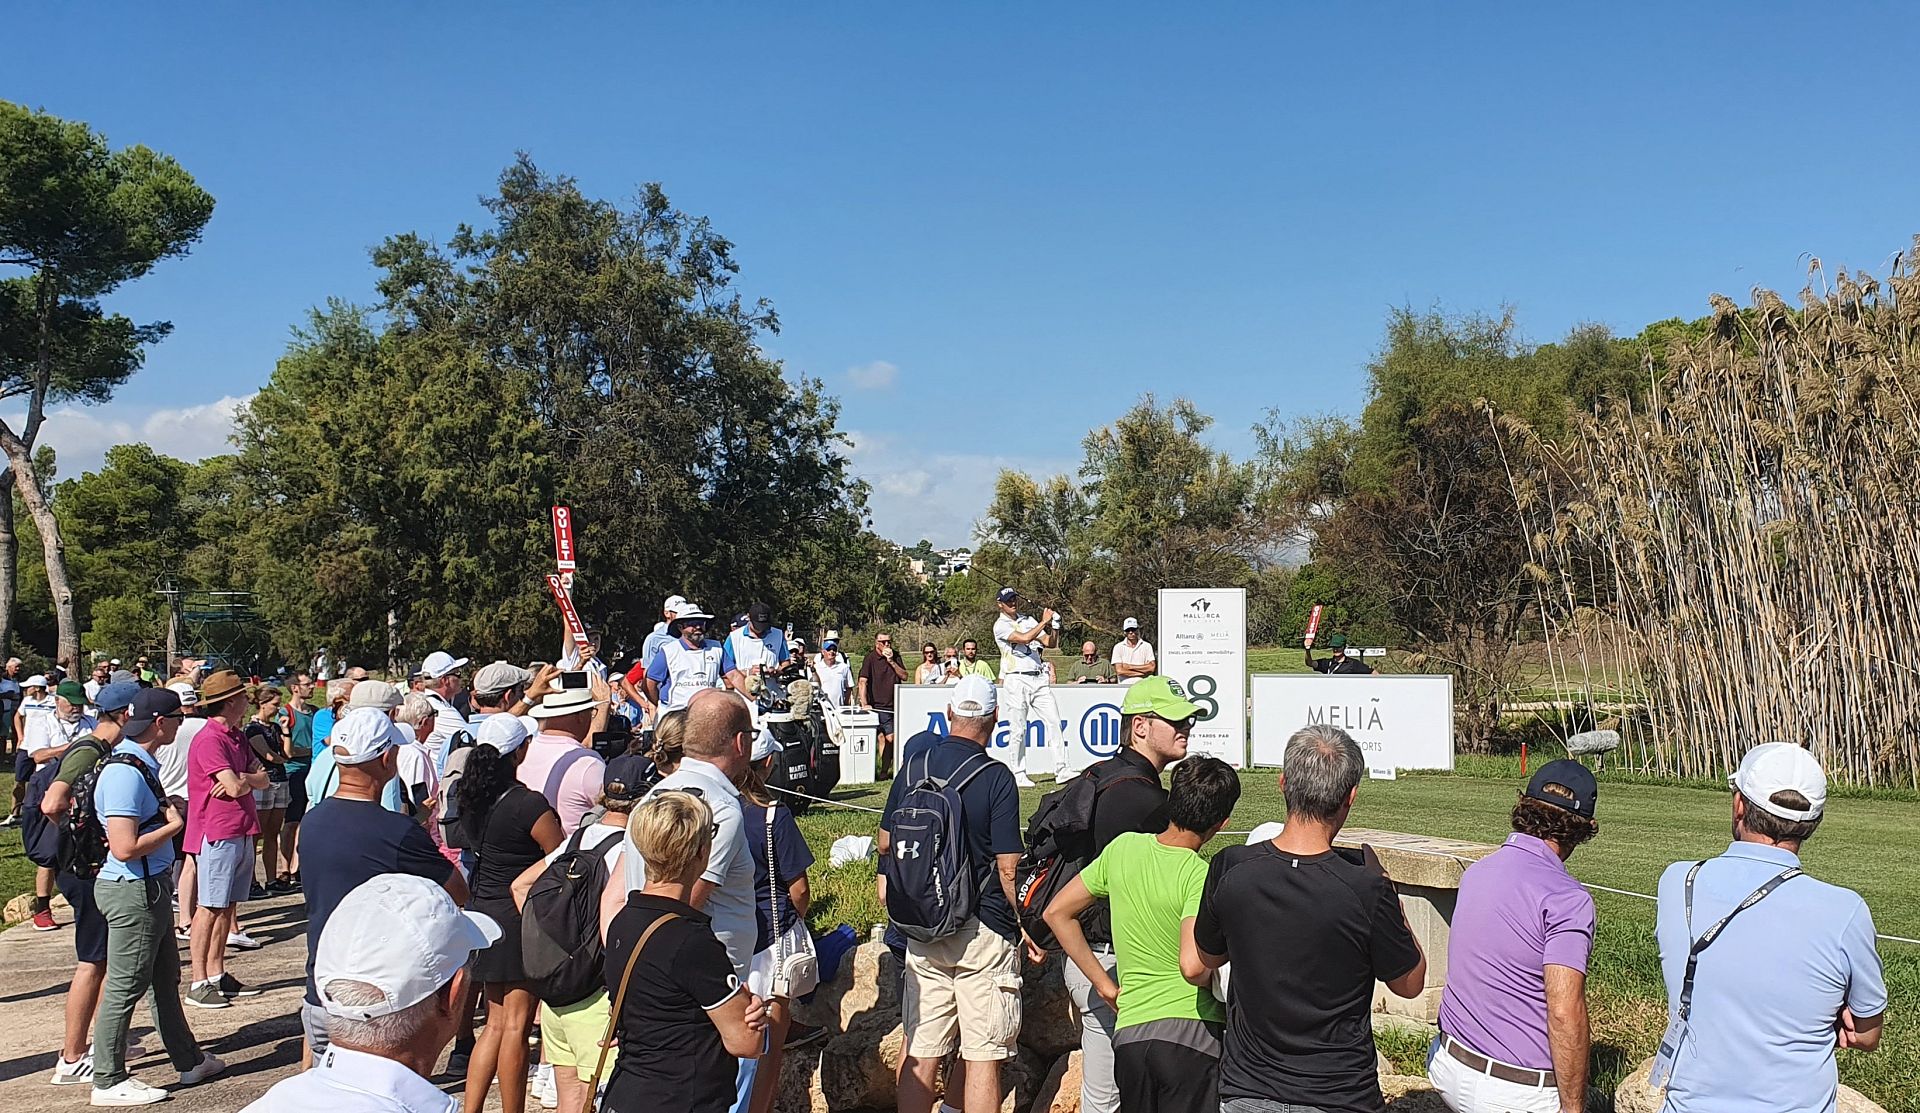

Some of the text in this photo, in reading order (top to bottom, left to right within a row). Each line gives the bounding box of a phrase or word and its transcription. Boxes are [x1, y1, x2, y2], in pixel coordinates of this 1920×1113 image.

[557, 508, 570, 560] QUIET
[550, 577, 579, 632] QUIET
[1187, 675, 1219, 722] 8
[927, 712, 1068, 748] Aanz
[1358, 741, 1382, 752] ORTS
